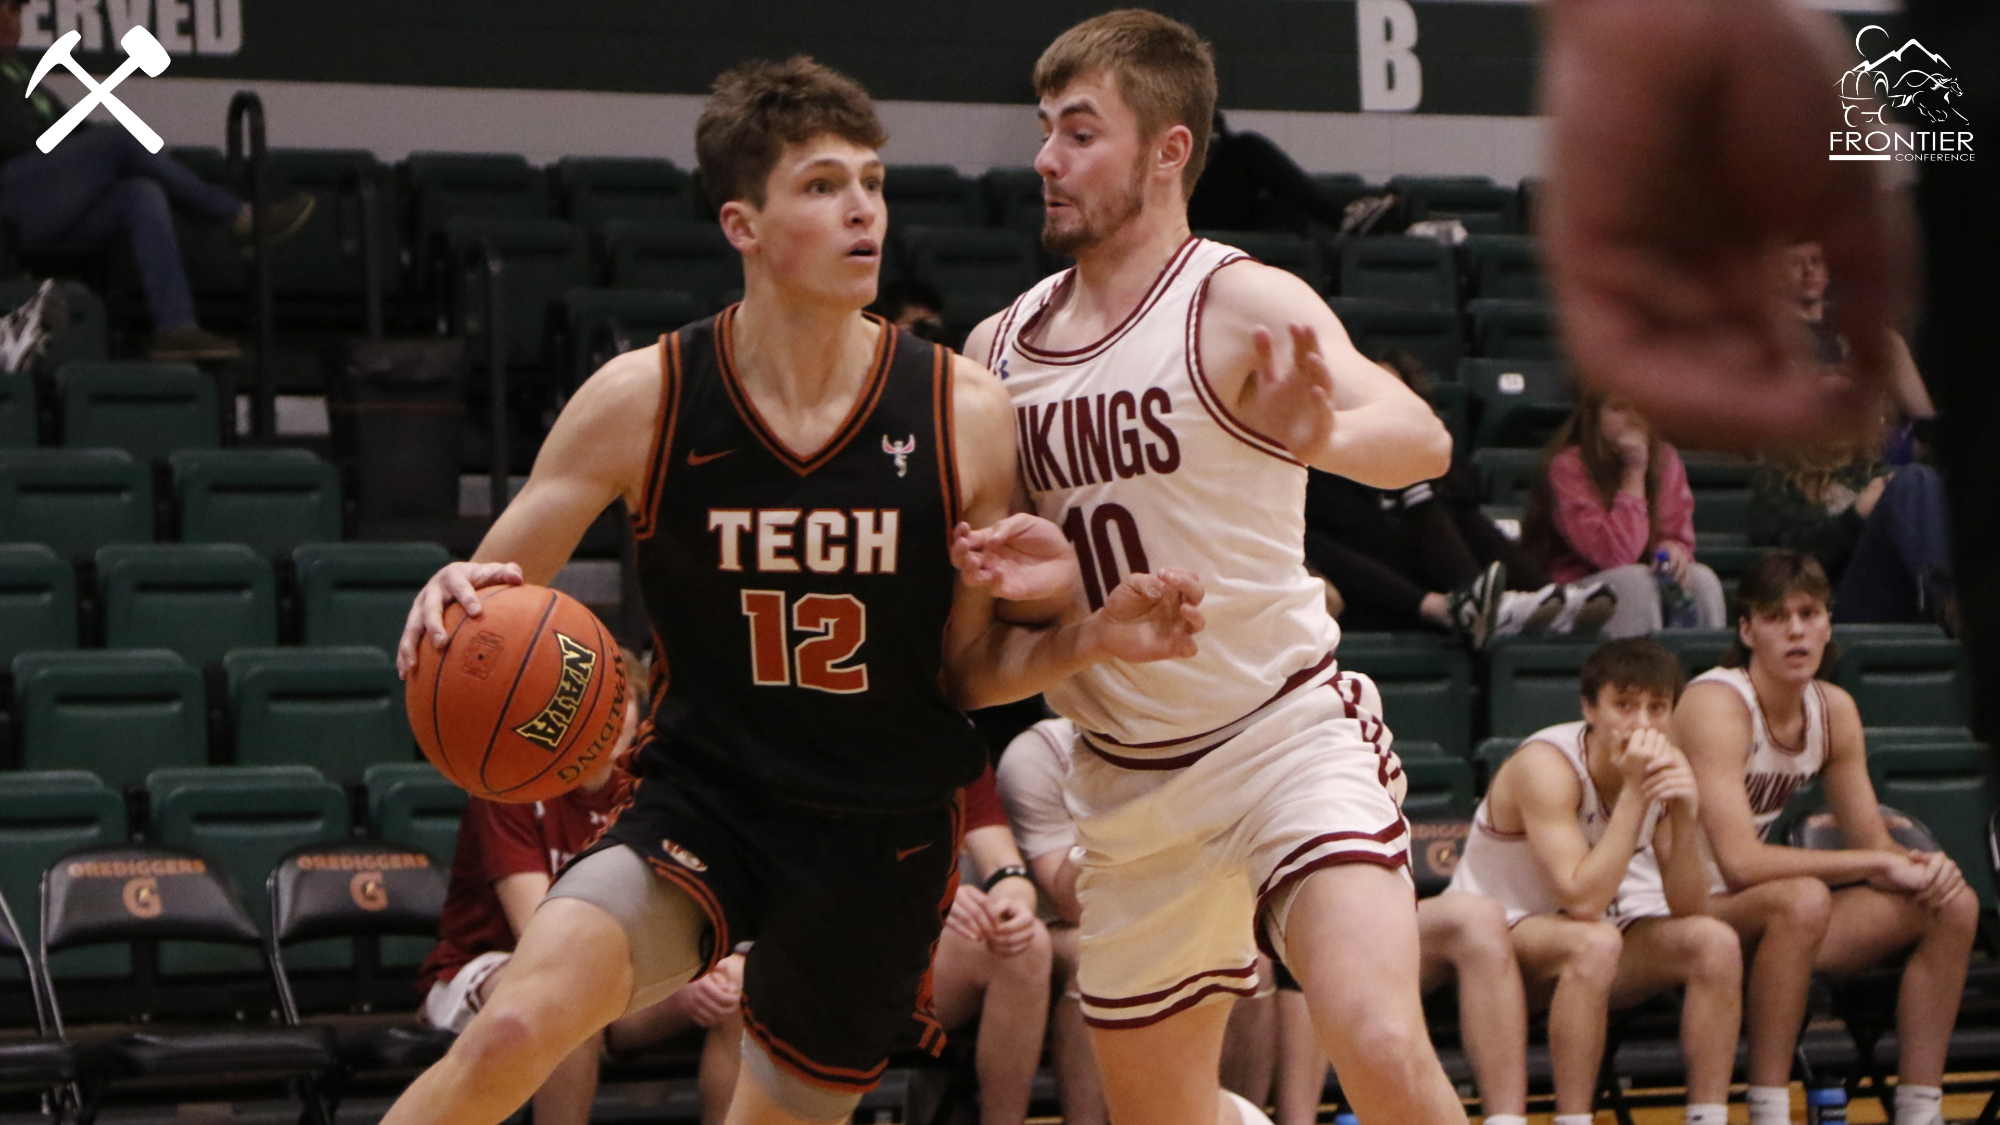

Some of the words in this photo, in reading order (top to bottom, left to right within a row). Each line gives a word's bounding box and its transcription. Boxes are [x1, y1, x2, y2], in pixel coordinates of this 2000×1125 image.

[1358, 0, 1422, 110] B
[1016, 386, 1181, 492] IKINGS
[706, 508, 900, 574] TECH
[1061, 502, 1151, 613] 10
[513, 631, 597, 751] NAIA
[740, 588, 869, 694] 12
[556, 653, 627, 784] SPALDING
[67, 858, 207, 878] OREDIGGERS
[295, 853, 430, 871] OREDIGGERS
